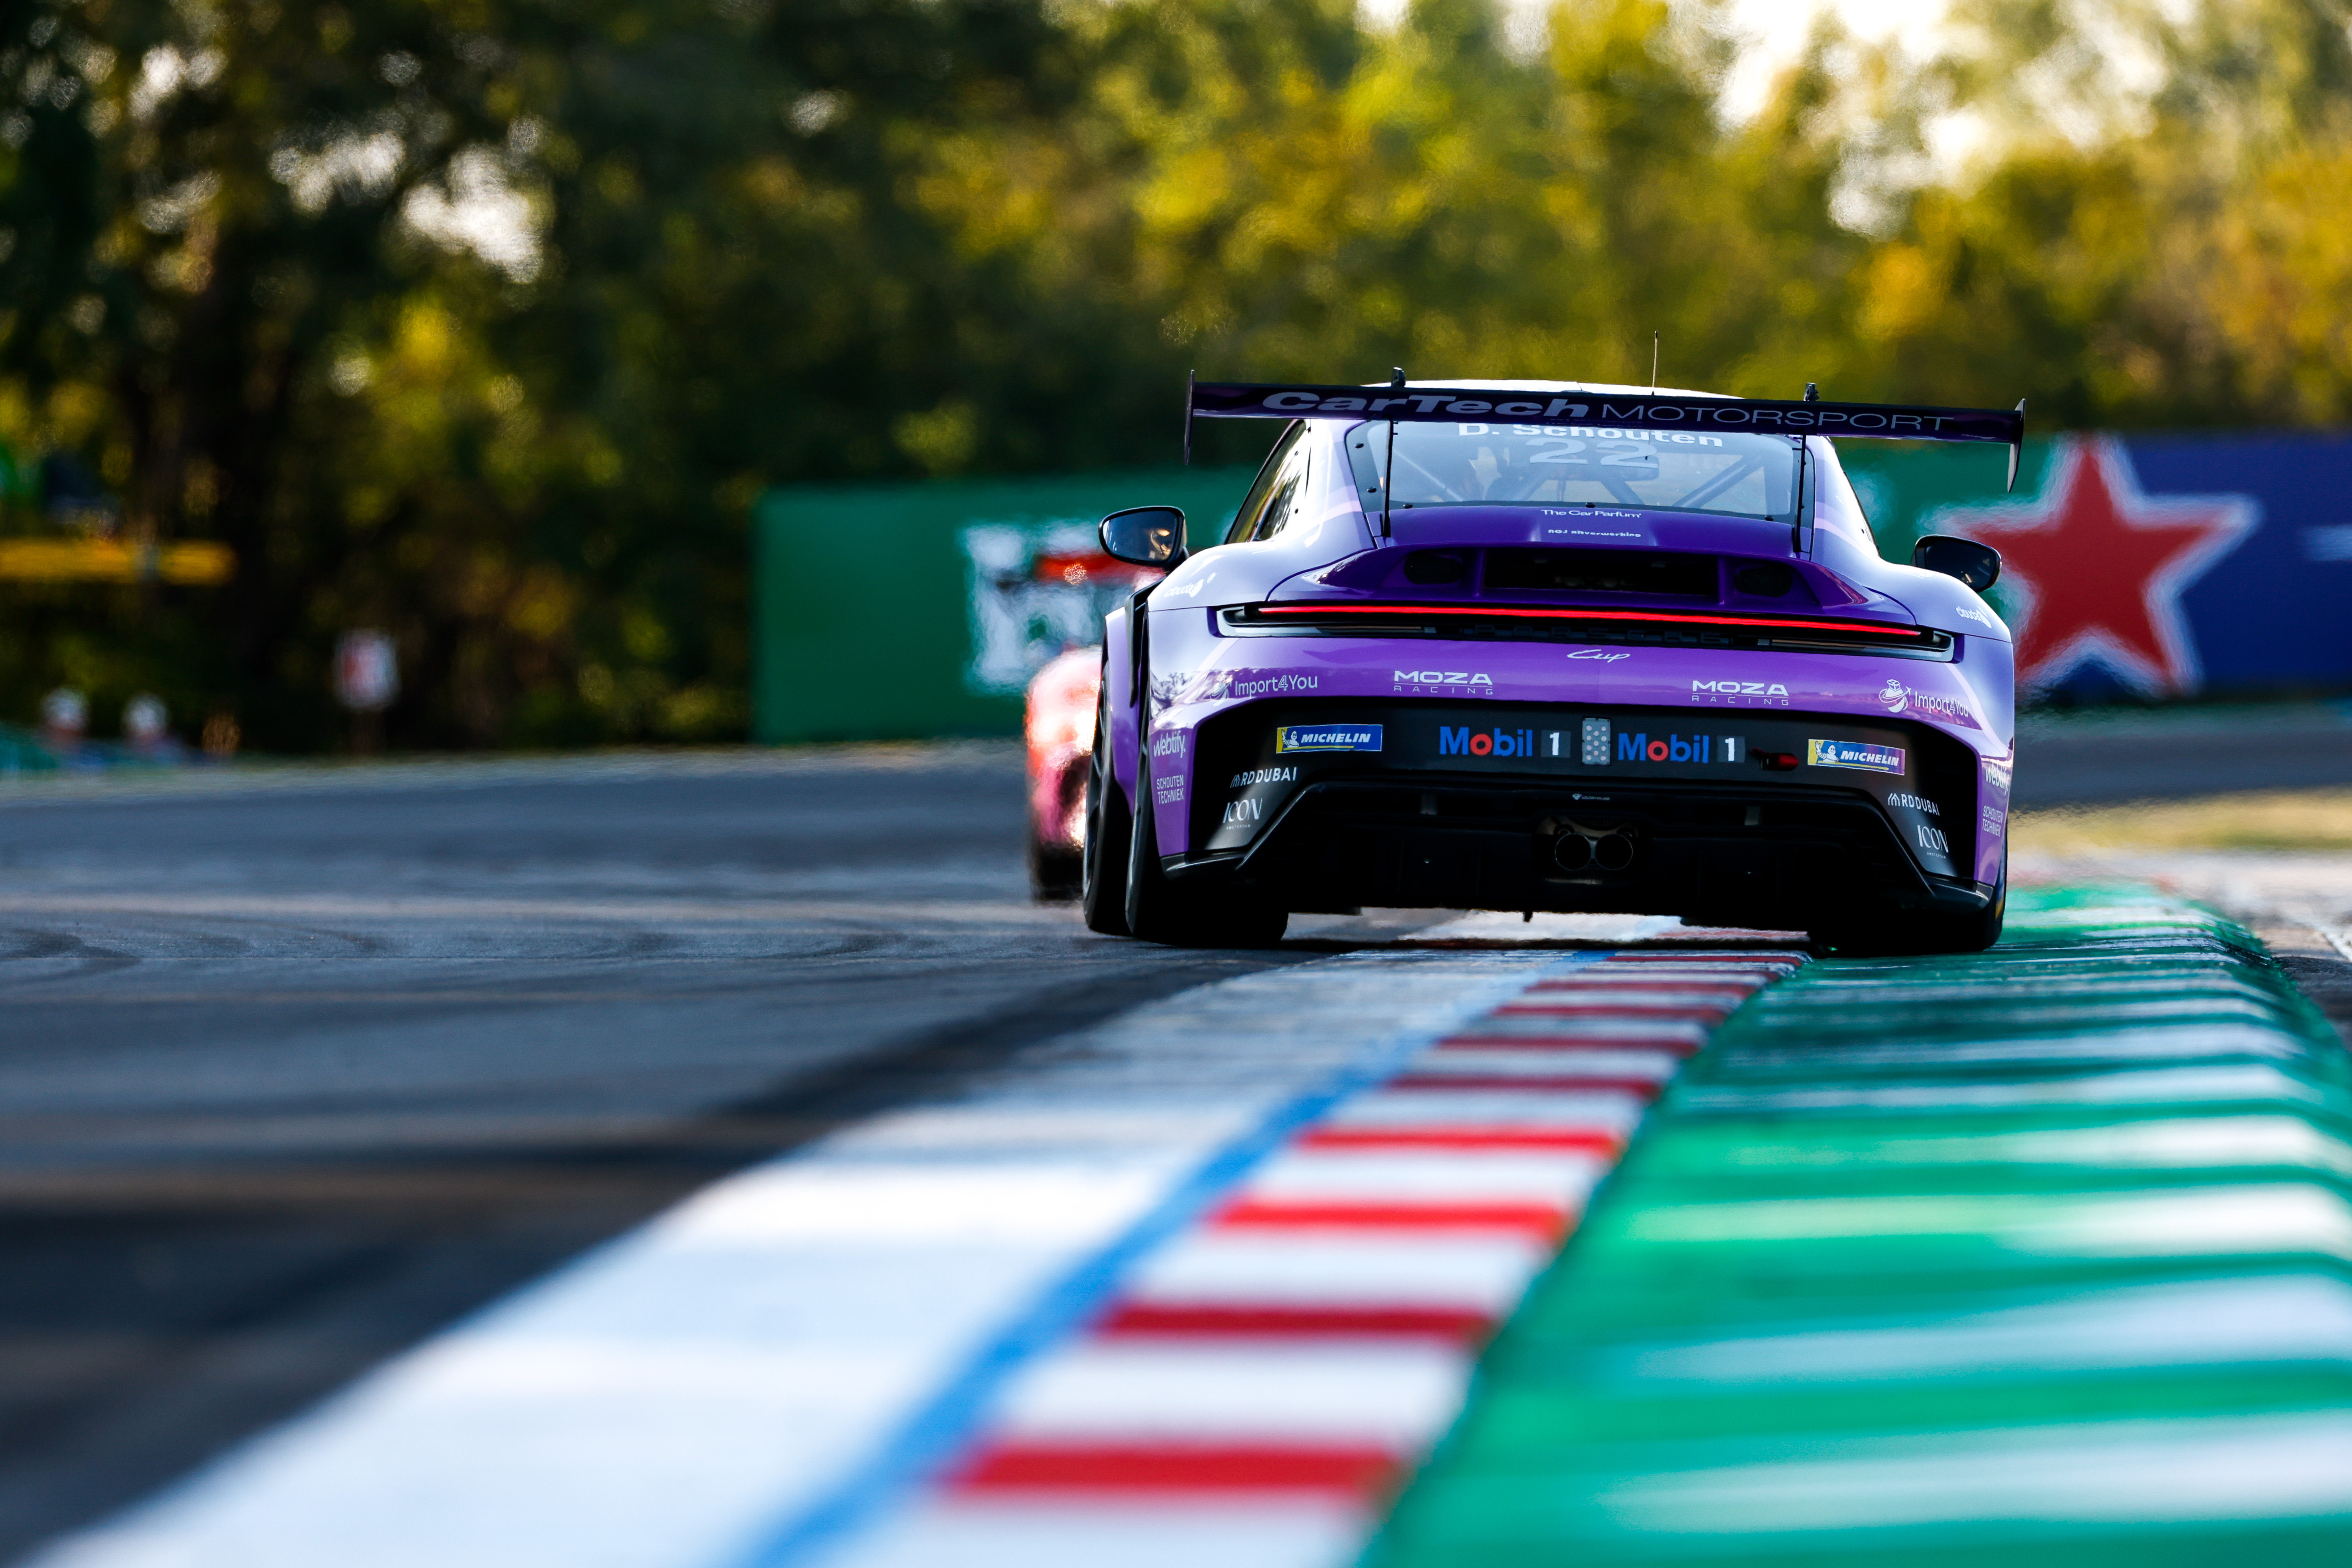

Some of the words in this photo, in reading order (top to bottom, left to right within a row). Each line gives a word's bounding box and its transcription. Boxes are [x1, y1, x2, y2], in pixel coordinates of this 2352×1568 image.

[1262, 392, 1590, 418] CarTech
[1601, 403, 1954, 432] MOTORSPORT
[1458, 423, 1499, 436] D.
[1513, 424, 1723, 447] Schouten
[1525, 437, 1659, 469] 22
[1567, 649, 1630, 663] Cup
[1235, 674, 1318, 699] Import4You
[1394, 670, 1493, 686] MOZA
[1394, 686, 1493, 695] RACING
[1692, 680, 1789, 696] MOZA
[1691, 695, 1789, 706] RACING
[1915, 691, 1968, 717] Import4You
[1301, 733, 1371, 743] MICHELIN
[1439, 726, 1533, 757] Mobil
[1549, 732, 1560, 756] 1
[1617, 733, 1709, 764] Mobil
[1724, 737, 1736, 761] 1
[1840, 750, 1900, 766] MICHELIN
[1156, 774, 1184, 790] SCHOUTEN
[1157, 787, 1184, 805] TECHNIEK
[1223, 798, 1263, 823] ICON
[1983, 805, 2004, 824] SCHOUTEN
[1982, 818, 2002, 837] TECHNIEK
[1917, 825, 1949, 853] ICON
